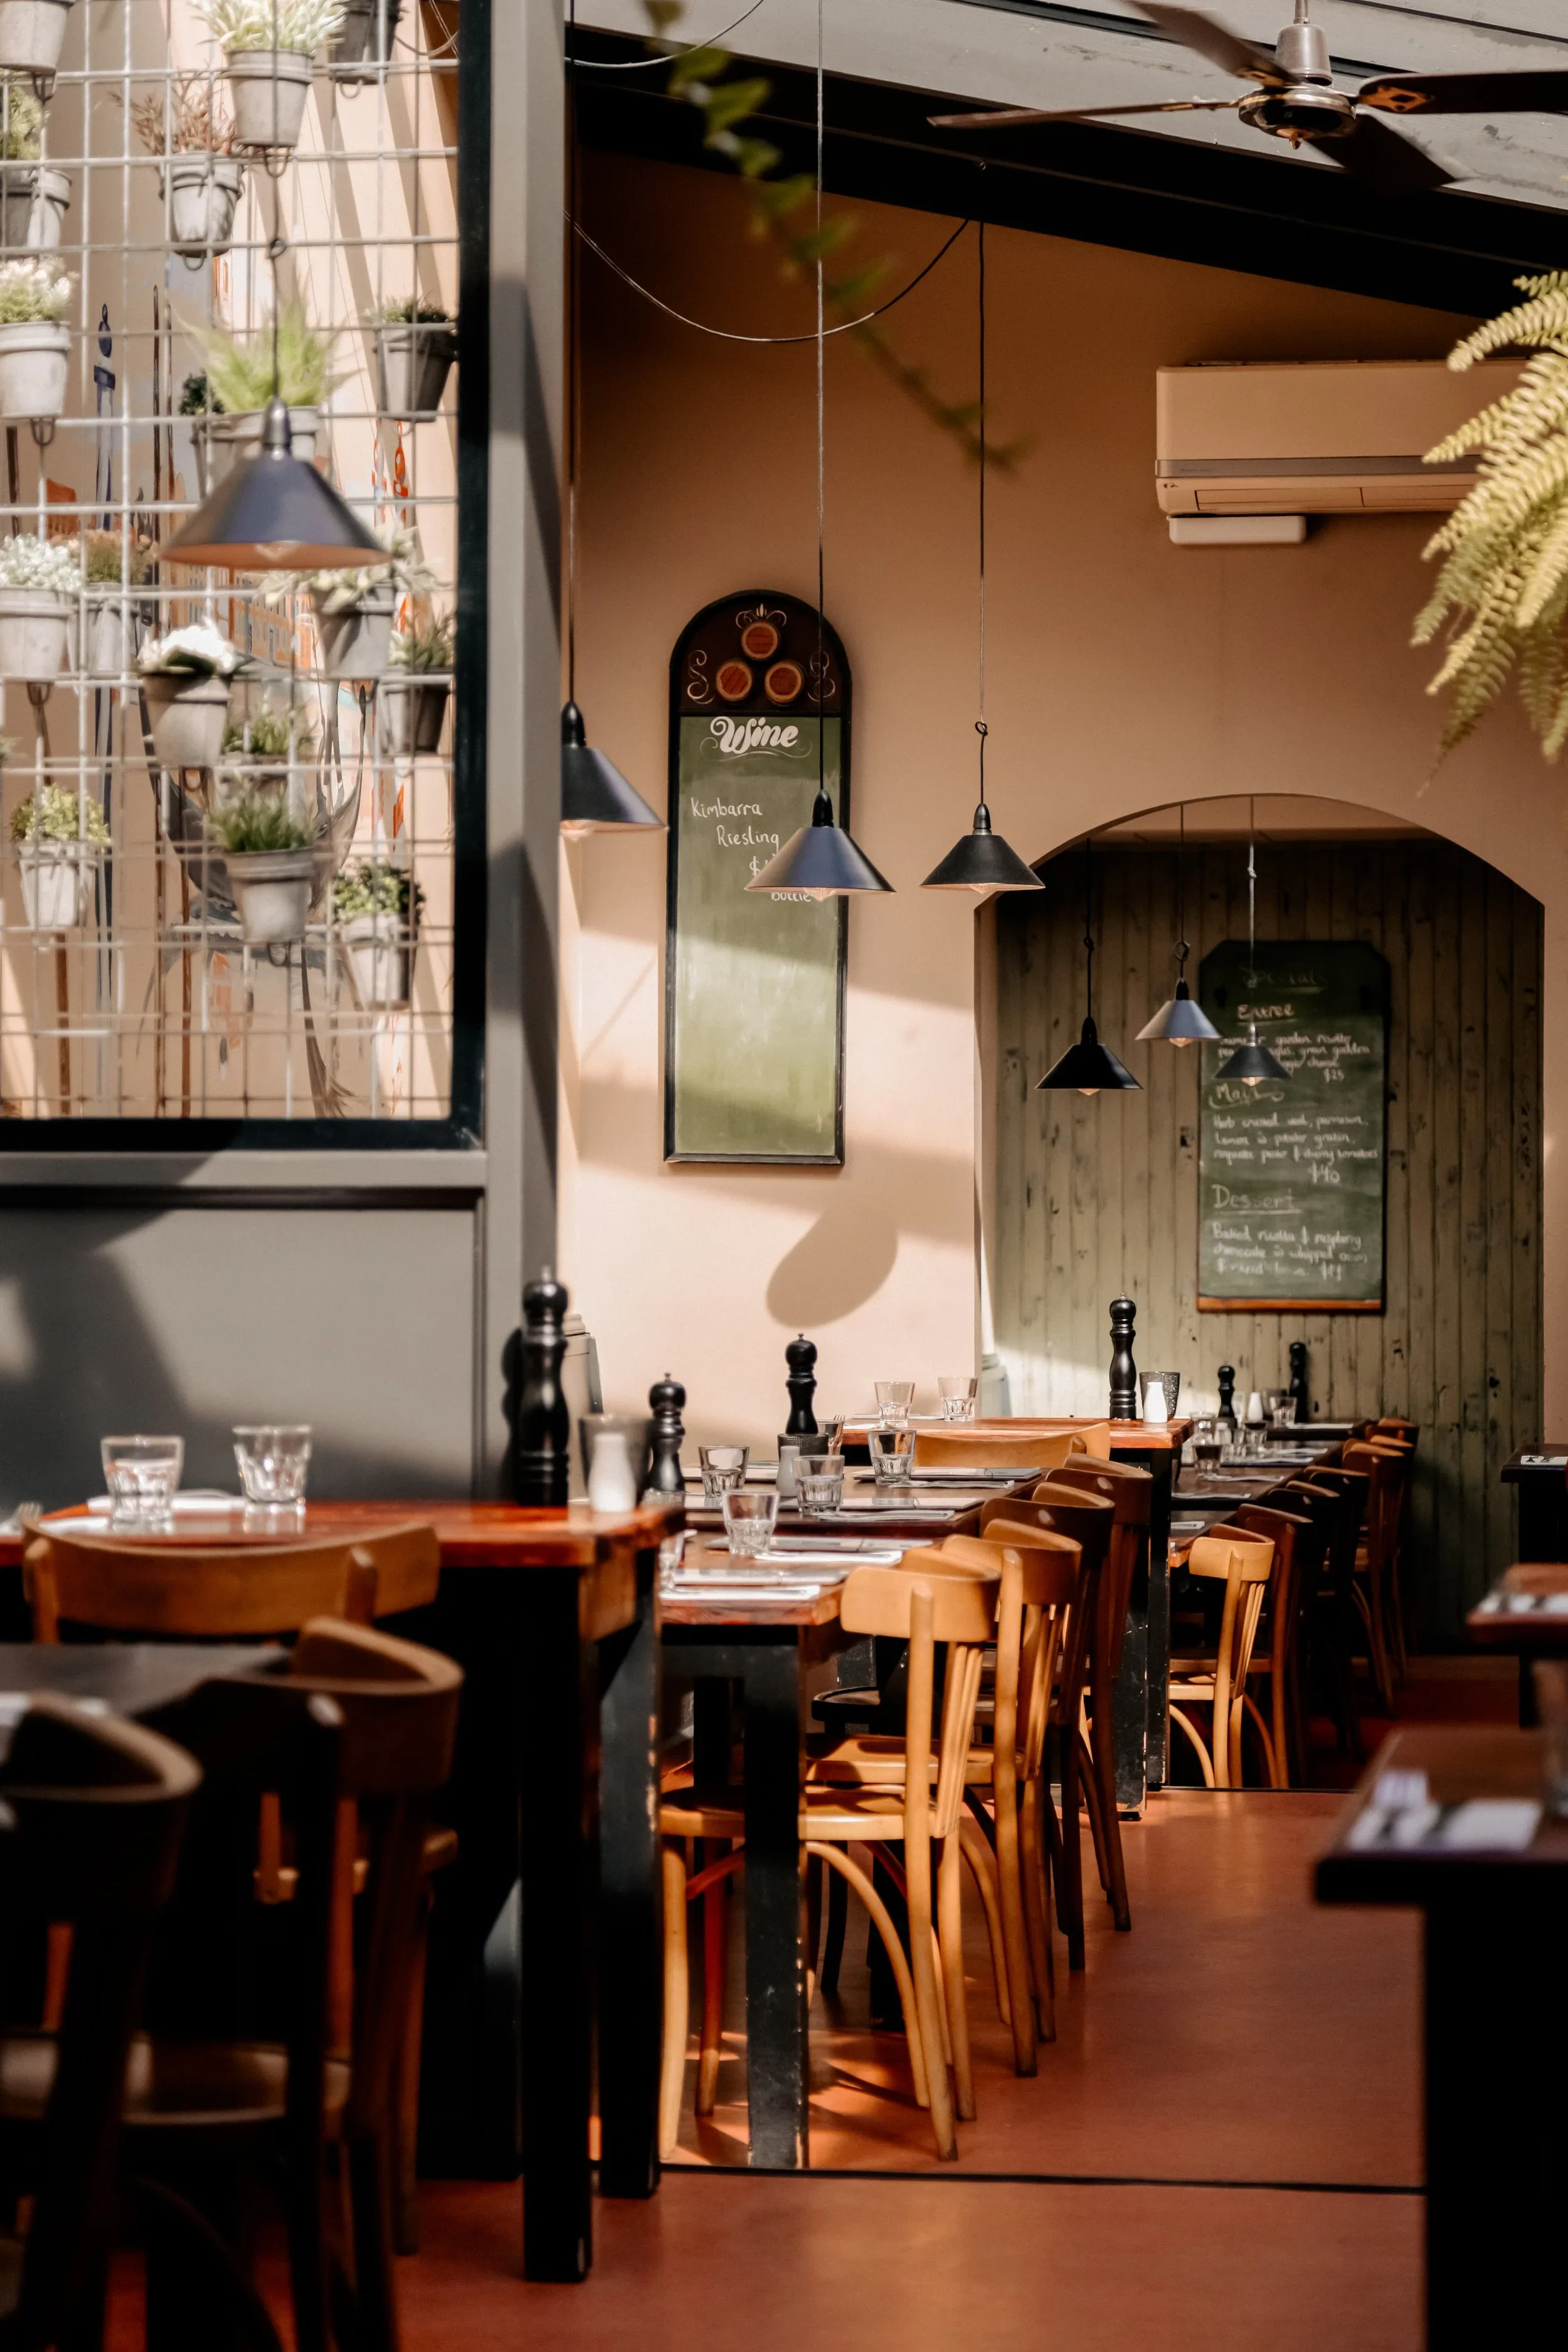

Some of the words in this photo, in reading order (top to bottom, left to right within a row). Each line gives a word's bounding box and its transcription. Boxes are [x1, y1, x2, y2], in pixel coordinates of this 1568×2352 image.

[710, 716, 799, 755] Wine
[691, 797, 763, 818] Kimbarra
[716, 825, 778, 854] Riesling
[1308, 1160, 1340, 1184] $40
[1211, 1184, 1295, 1209] Dessert
